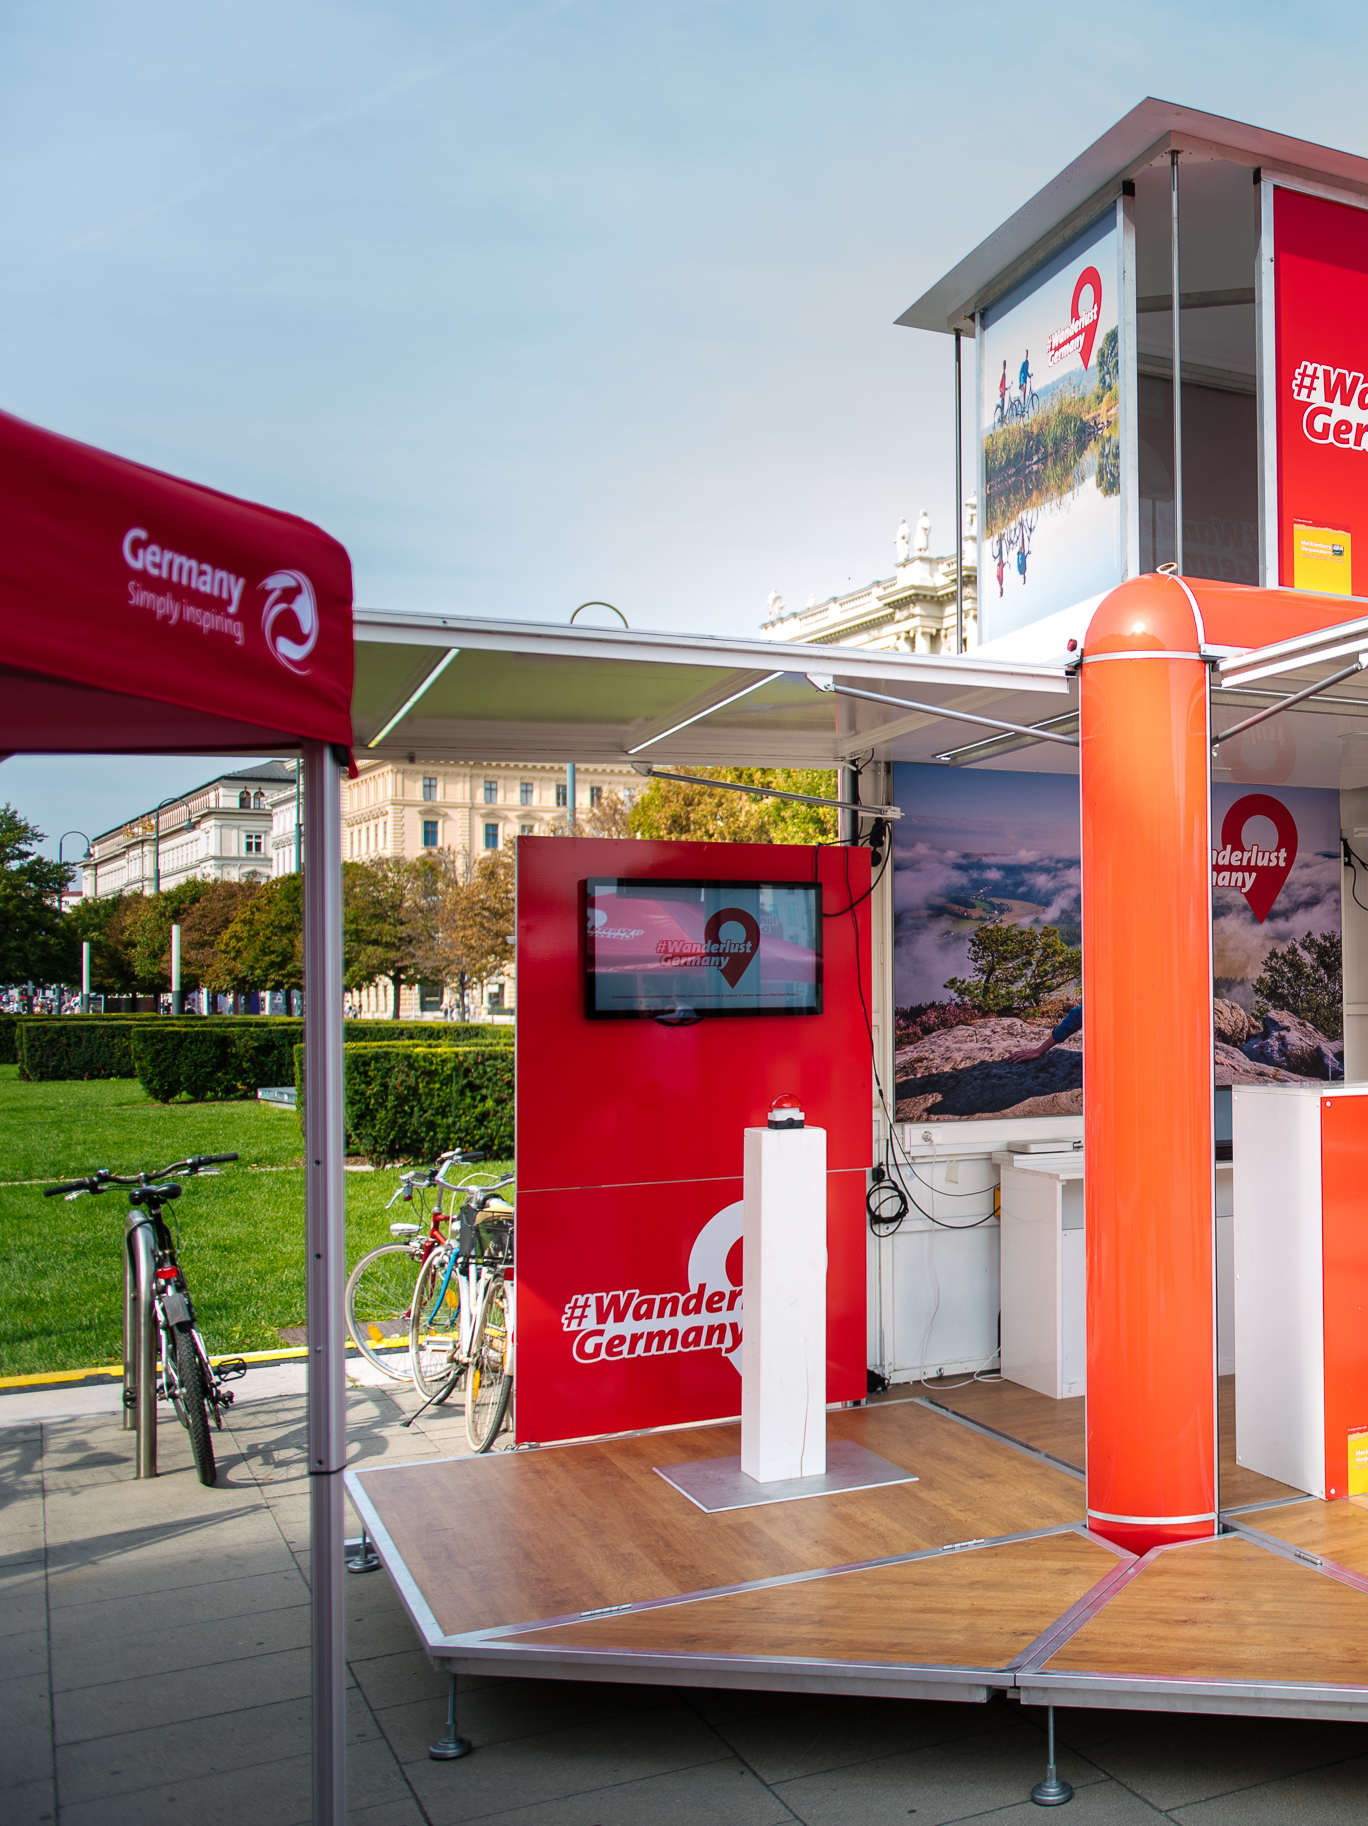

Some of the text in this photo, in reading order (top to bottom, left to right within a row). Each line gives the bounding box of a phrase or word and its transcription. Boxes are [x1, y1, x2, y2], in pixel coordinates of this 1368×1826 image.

[1046, 303, 1098, 354] #Wanderlust
[1048, 332, 1085, 368] Germany
[122, 527, 246, 614] Germany
[127, 580, 245, 646] Simply inspiring
[655, 939, 752, 954] #Wanderlust
[660, 954, 729, 969] Germany
[562, 1283, 743, 1329] #Wander
[576, 1322, 743, 1361] Germany
